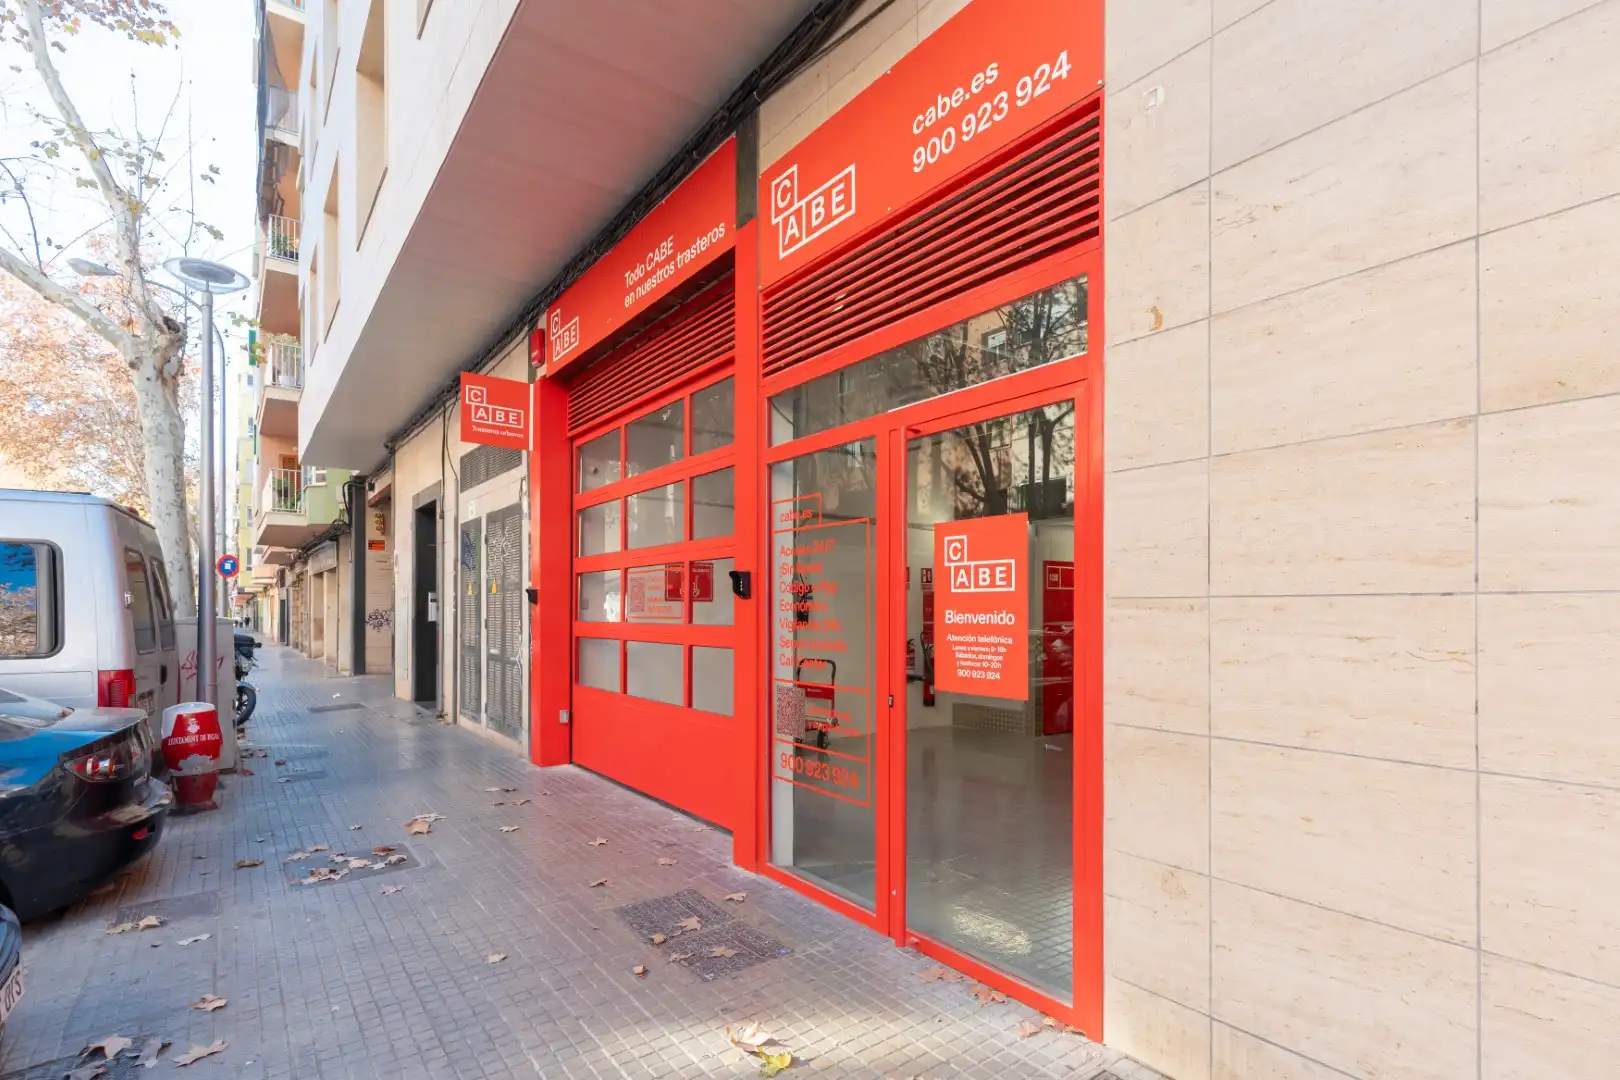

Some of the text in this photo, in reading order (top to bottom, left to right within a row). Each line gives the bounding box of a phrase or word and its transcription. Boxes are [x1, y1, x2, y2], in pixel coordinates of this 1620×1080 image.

[913, 62, 998, 135] cabe.es
[913, 50, 1072, 173] 900 923 924
[624, 235, 674, 288] Todo CABE
[624, 222, 725, 308] en nuestros trasteros
[779, 543, 811, 557] Acc
[780, 598, 829, 612] Econó
[945, 609, 1015, 625] Bienvenido
[780, 634, 812, 649] Seg
[947, 633, 1013, 645] Atención telefónica
[957, 669, 1001, 680] 900 923 924
[781, 752, 860, 792] 900 923 924
